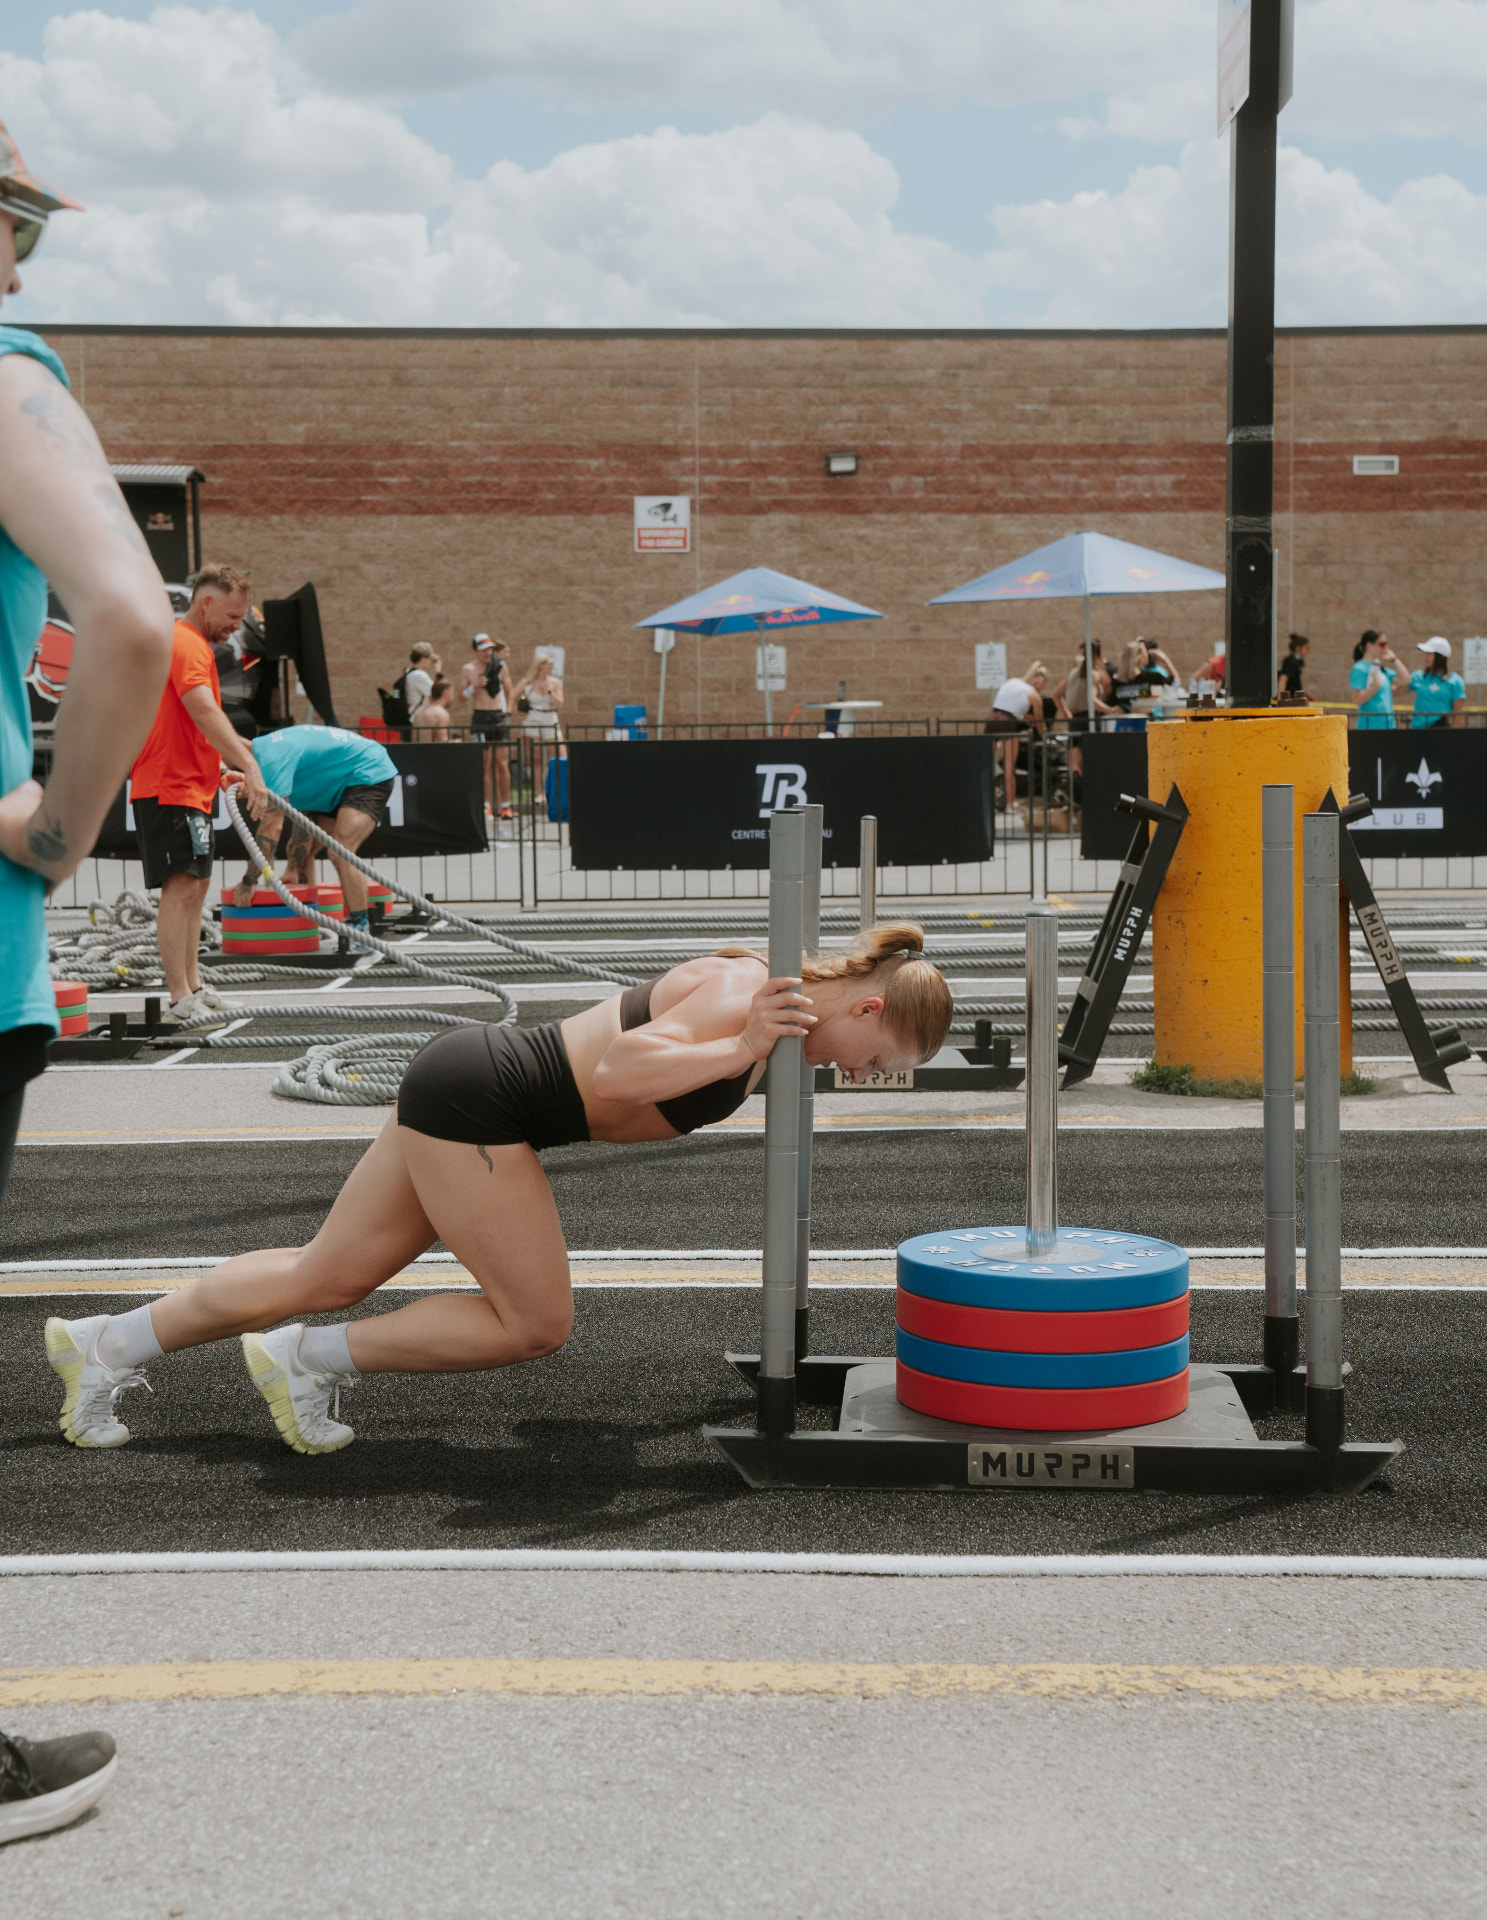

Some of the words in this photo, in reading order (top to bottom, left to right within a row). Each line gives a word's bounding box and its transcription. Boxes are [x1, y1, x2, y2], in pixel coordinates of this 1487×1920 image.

[1350, 812, 1426, 826] LUB
[731, 829, 766, 840] CENTRE
[1113, 906, 1143, 962] MURPH
[1363, 912, 1399, 976] MURPH
[949, 1230, 1130, 1245] MUPH
[982, 1451, 1120, 1480] MURPH
